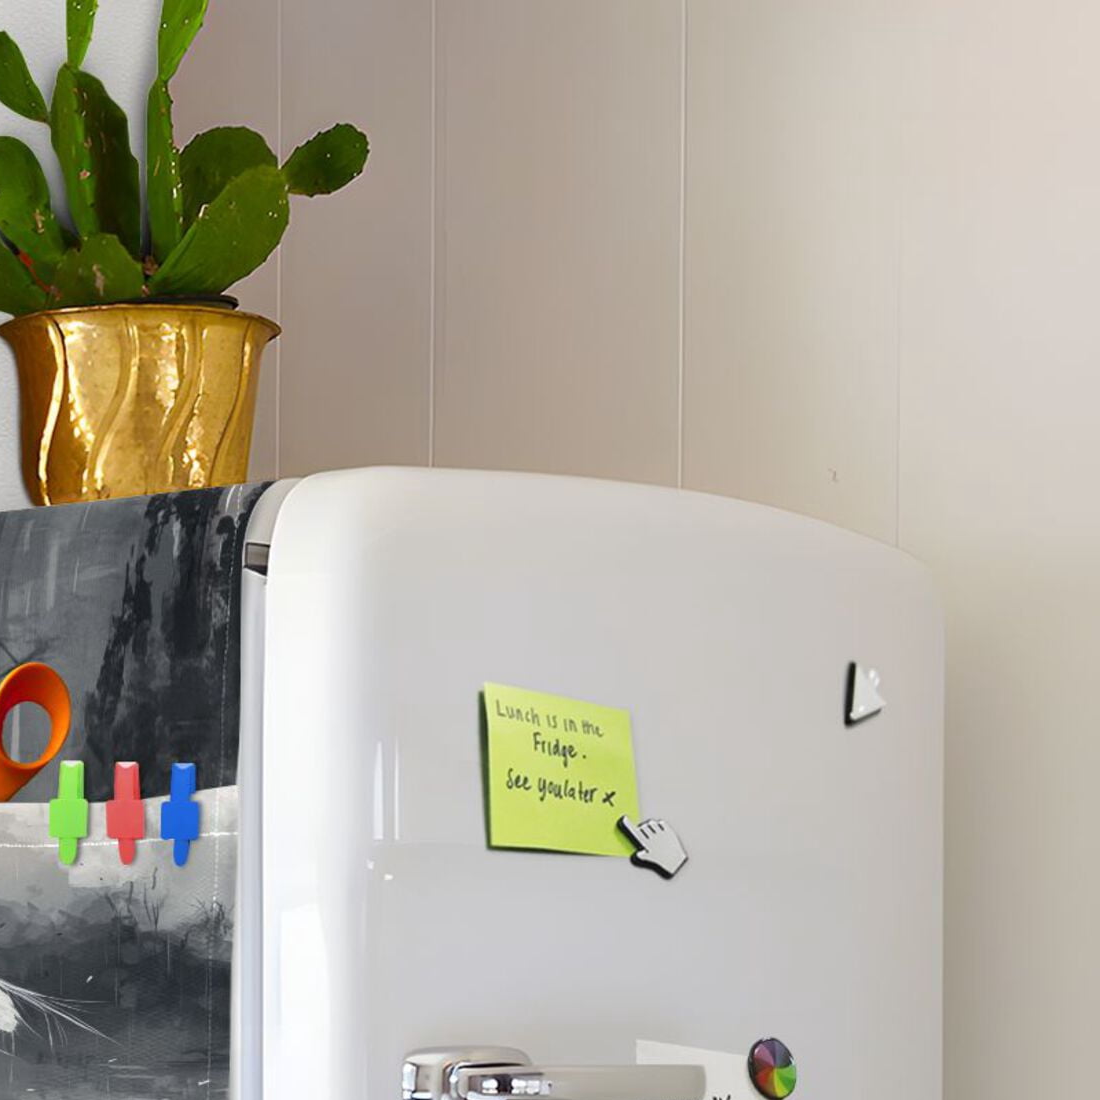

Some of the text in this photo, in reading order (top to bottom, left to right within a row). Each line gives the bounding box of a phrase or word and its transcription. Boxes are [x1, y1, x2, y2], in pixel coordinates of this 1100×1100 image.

[495, 699, 540, 727] Lunch
[564, 718, 577, 733] in
[582, 719, 604, 737] the
[506, 768, 531, 790] See
